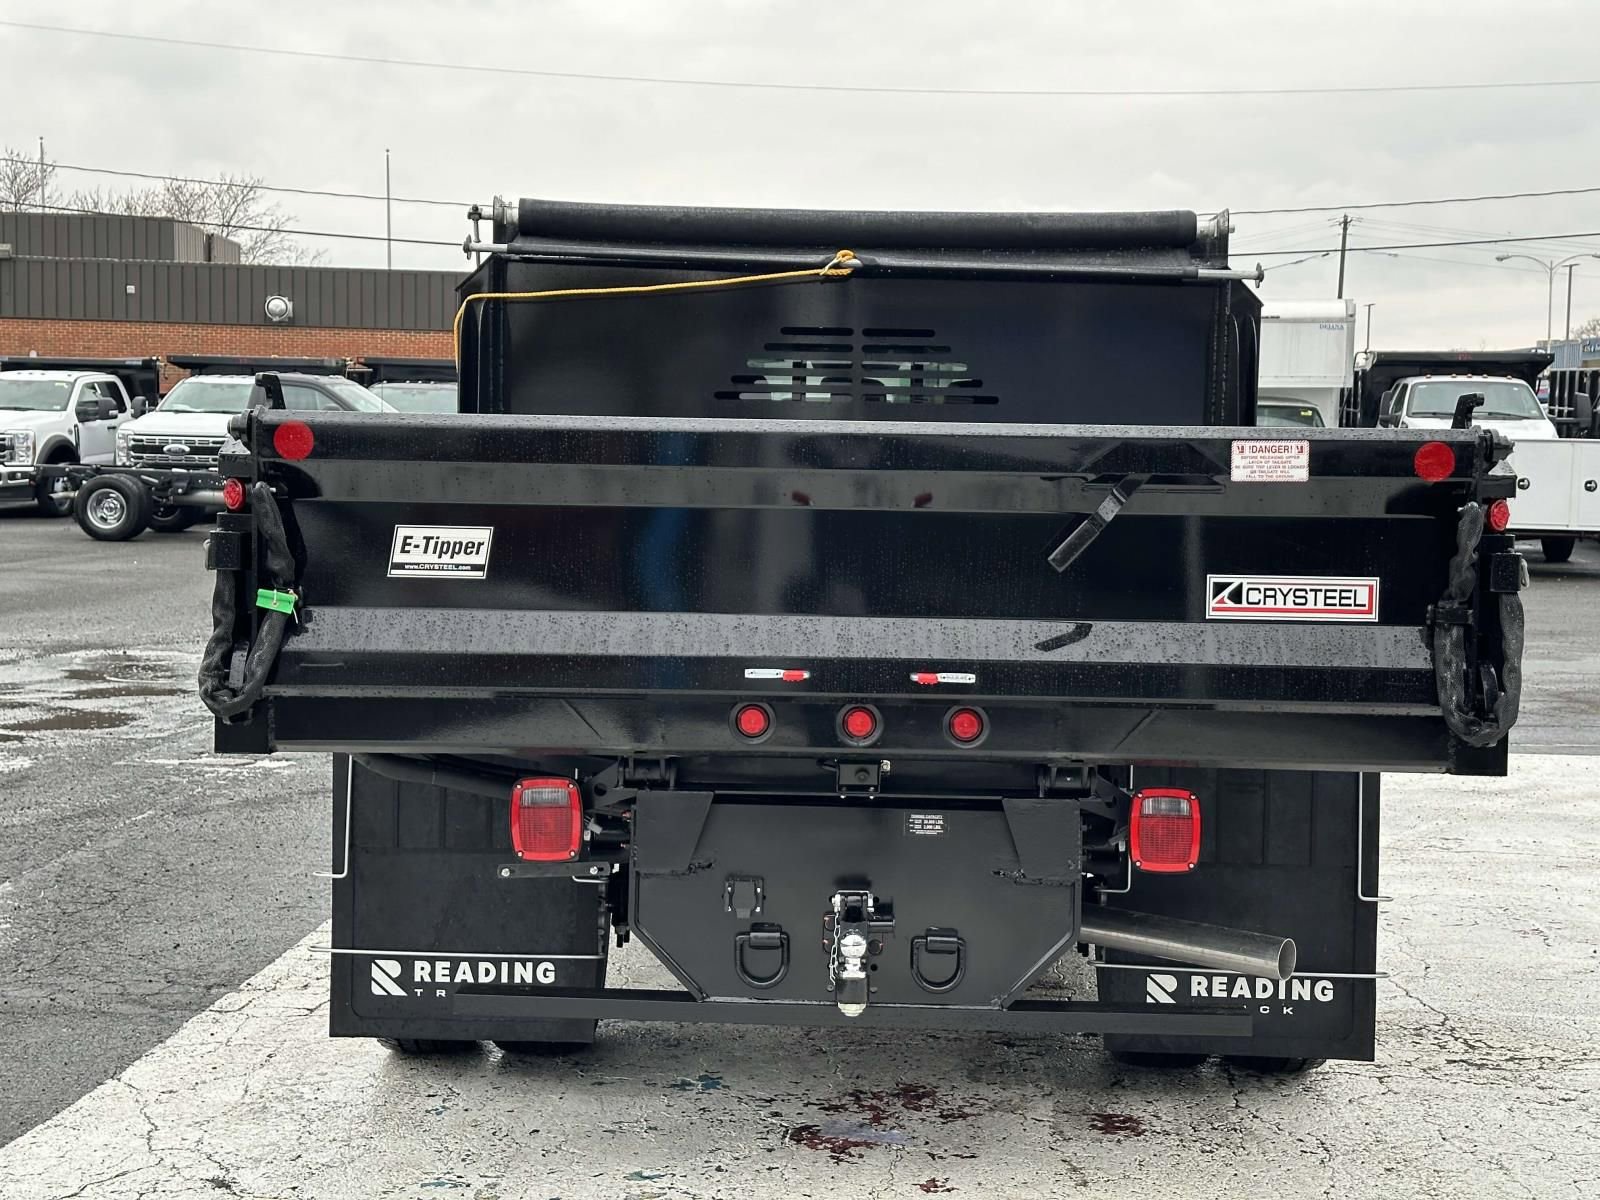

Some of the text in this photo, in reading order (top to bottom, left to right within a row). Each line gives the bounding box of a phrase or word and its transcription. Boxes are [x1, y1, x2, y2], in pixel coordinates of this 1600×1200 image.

[400, 535, 485, 559] E-Tipper
[1246, 587, 1366, 607] CRYSTEEL
[414, 960, 556, 984] READING
[1190, 975, 1334, 1002] READING
